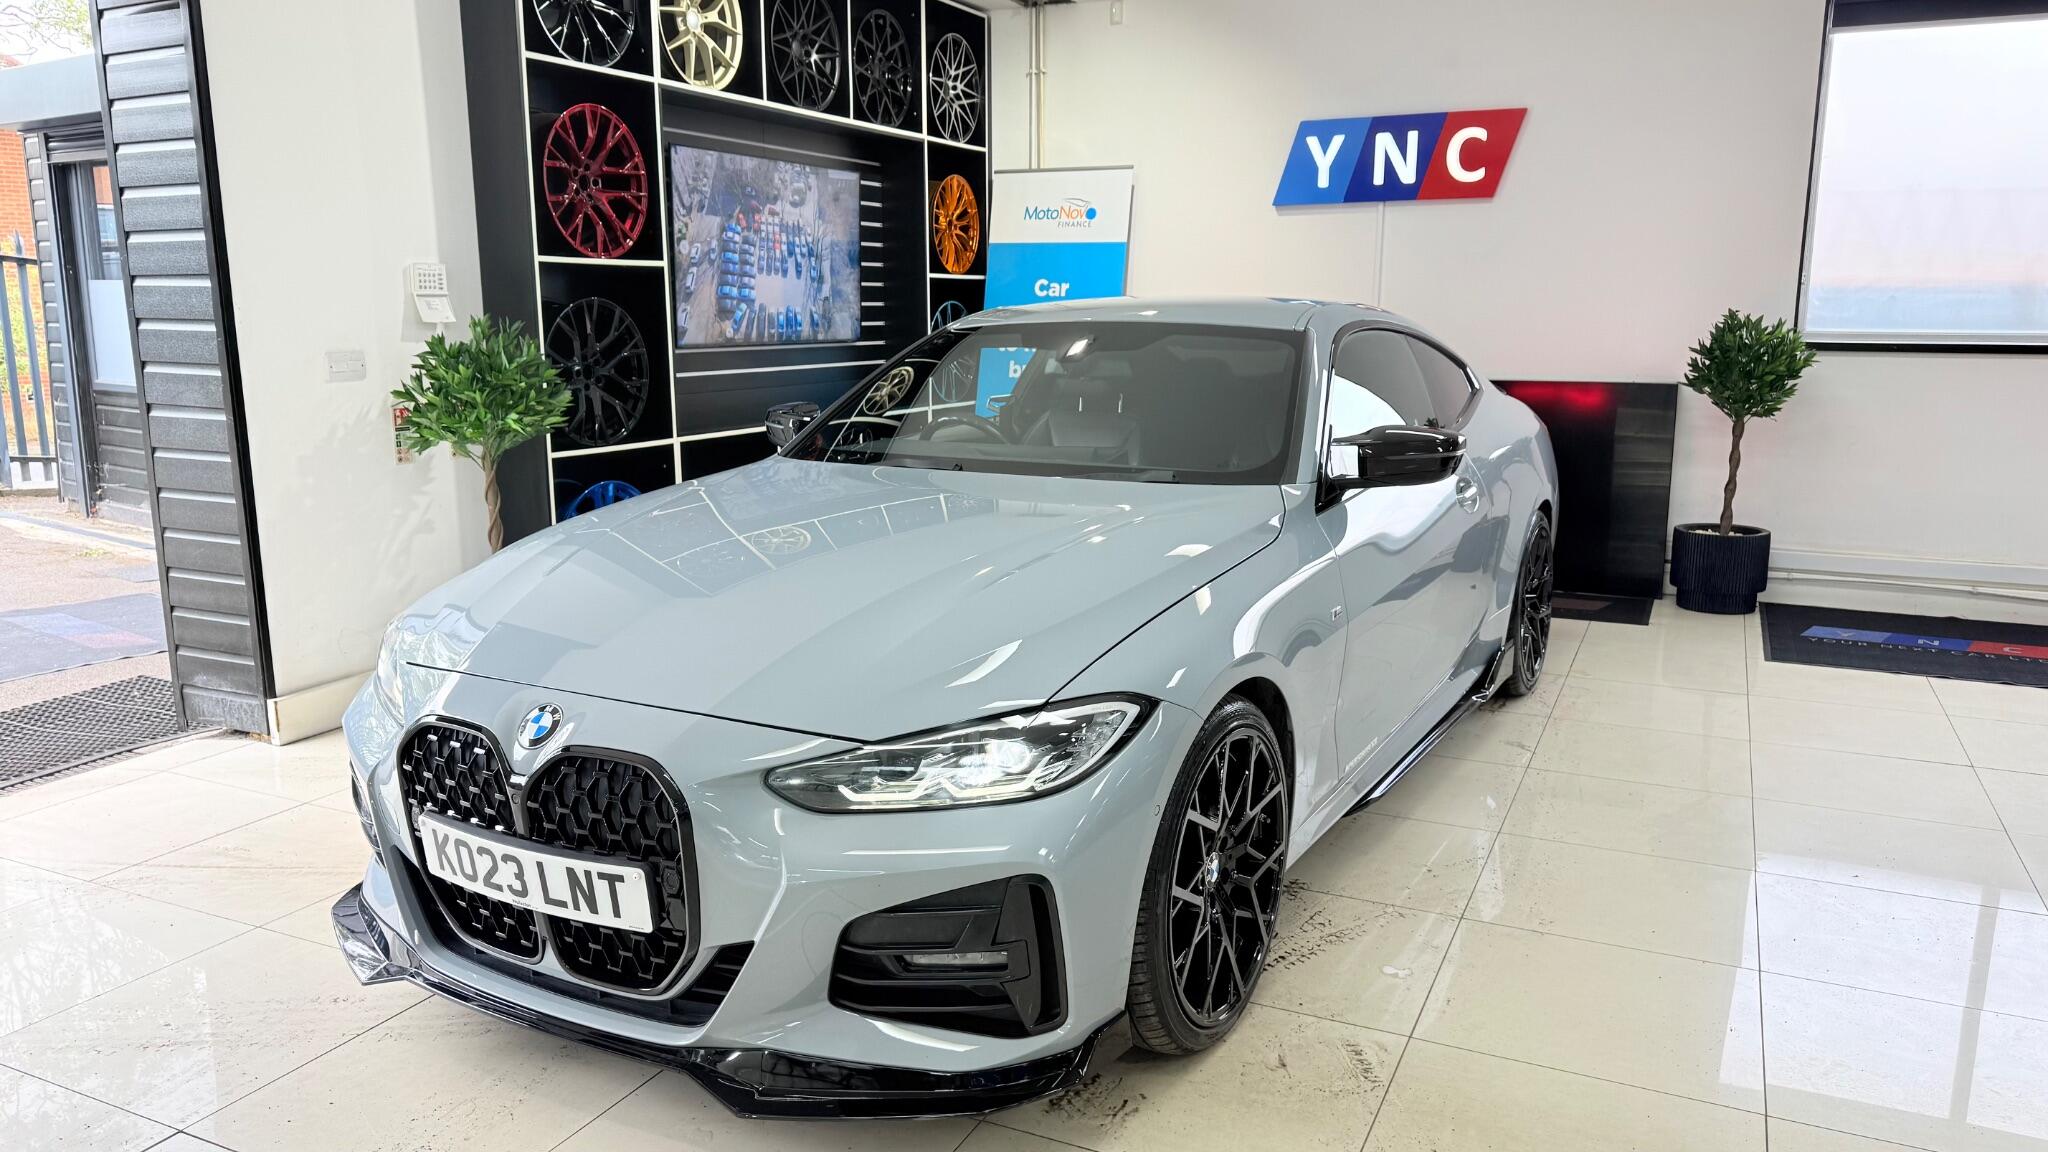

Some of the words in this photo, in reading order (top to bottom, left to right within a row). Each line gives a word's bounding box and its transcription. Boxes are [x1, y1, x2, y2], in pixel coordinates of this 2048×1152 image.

[1057, 220, 1093, 229] FINANCE
[1033, 278, 1070, 297] Car
[1808, 637, 1868, 647] YOUR
[431, 828, 529, 899] KO23
[535, 860, 625, 919] LNT
